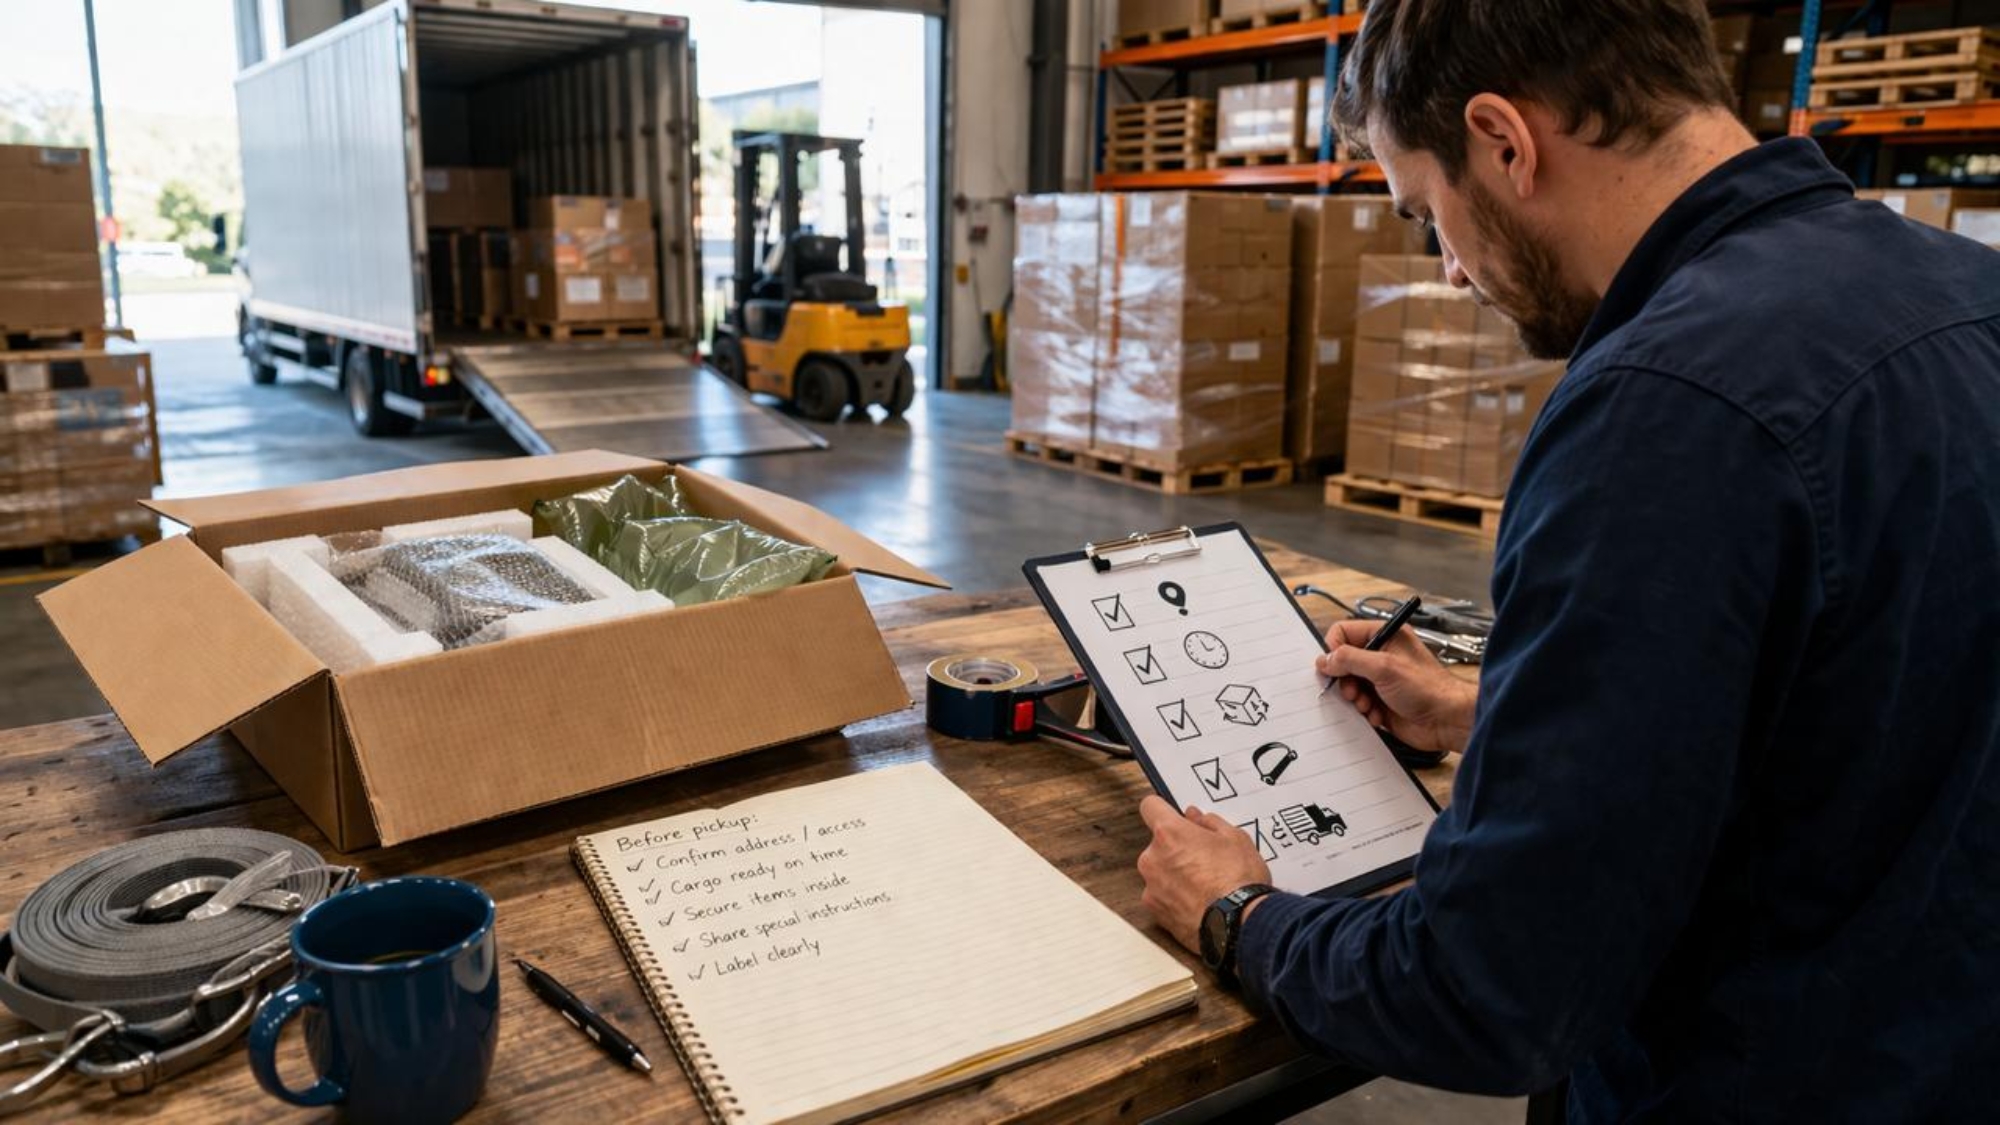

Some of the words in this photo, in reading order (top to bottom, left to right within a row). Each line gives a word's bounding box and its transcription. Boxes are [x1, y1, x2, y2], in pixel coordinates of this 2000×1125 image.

[616, 831, 682, 851] Before
[692, 813, 759, 839] pickup:
[655, 847, 726, 869] Confirm
[735, 833, 795, 852] address
[803, 825, 808, 842] /
[818, 817, 866, 837] access
[671, 877, 722, 895] Cargo
[730, 864, 776, 883] ready
[784, 857, 803, 869] on
[810, 846, 849, 863] time
[683, 901, 742, 922] Secure
[751, 886, 796, 906] items
[805, 873, 850, 895] inside
[699, 928, 749, 949] Share
[754, 911, 801, 936] special
[808, 891, 892, 922] instructions
[716, 955, 759, 976] Label
[767, 938, 821, 964] clearly
